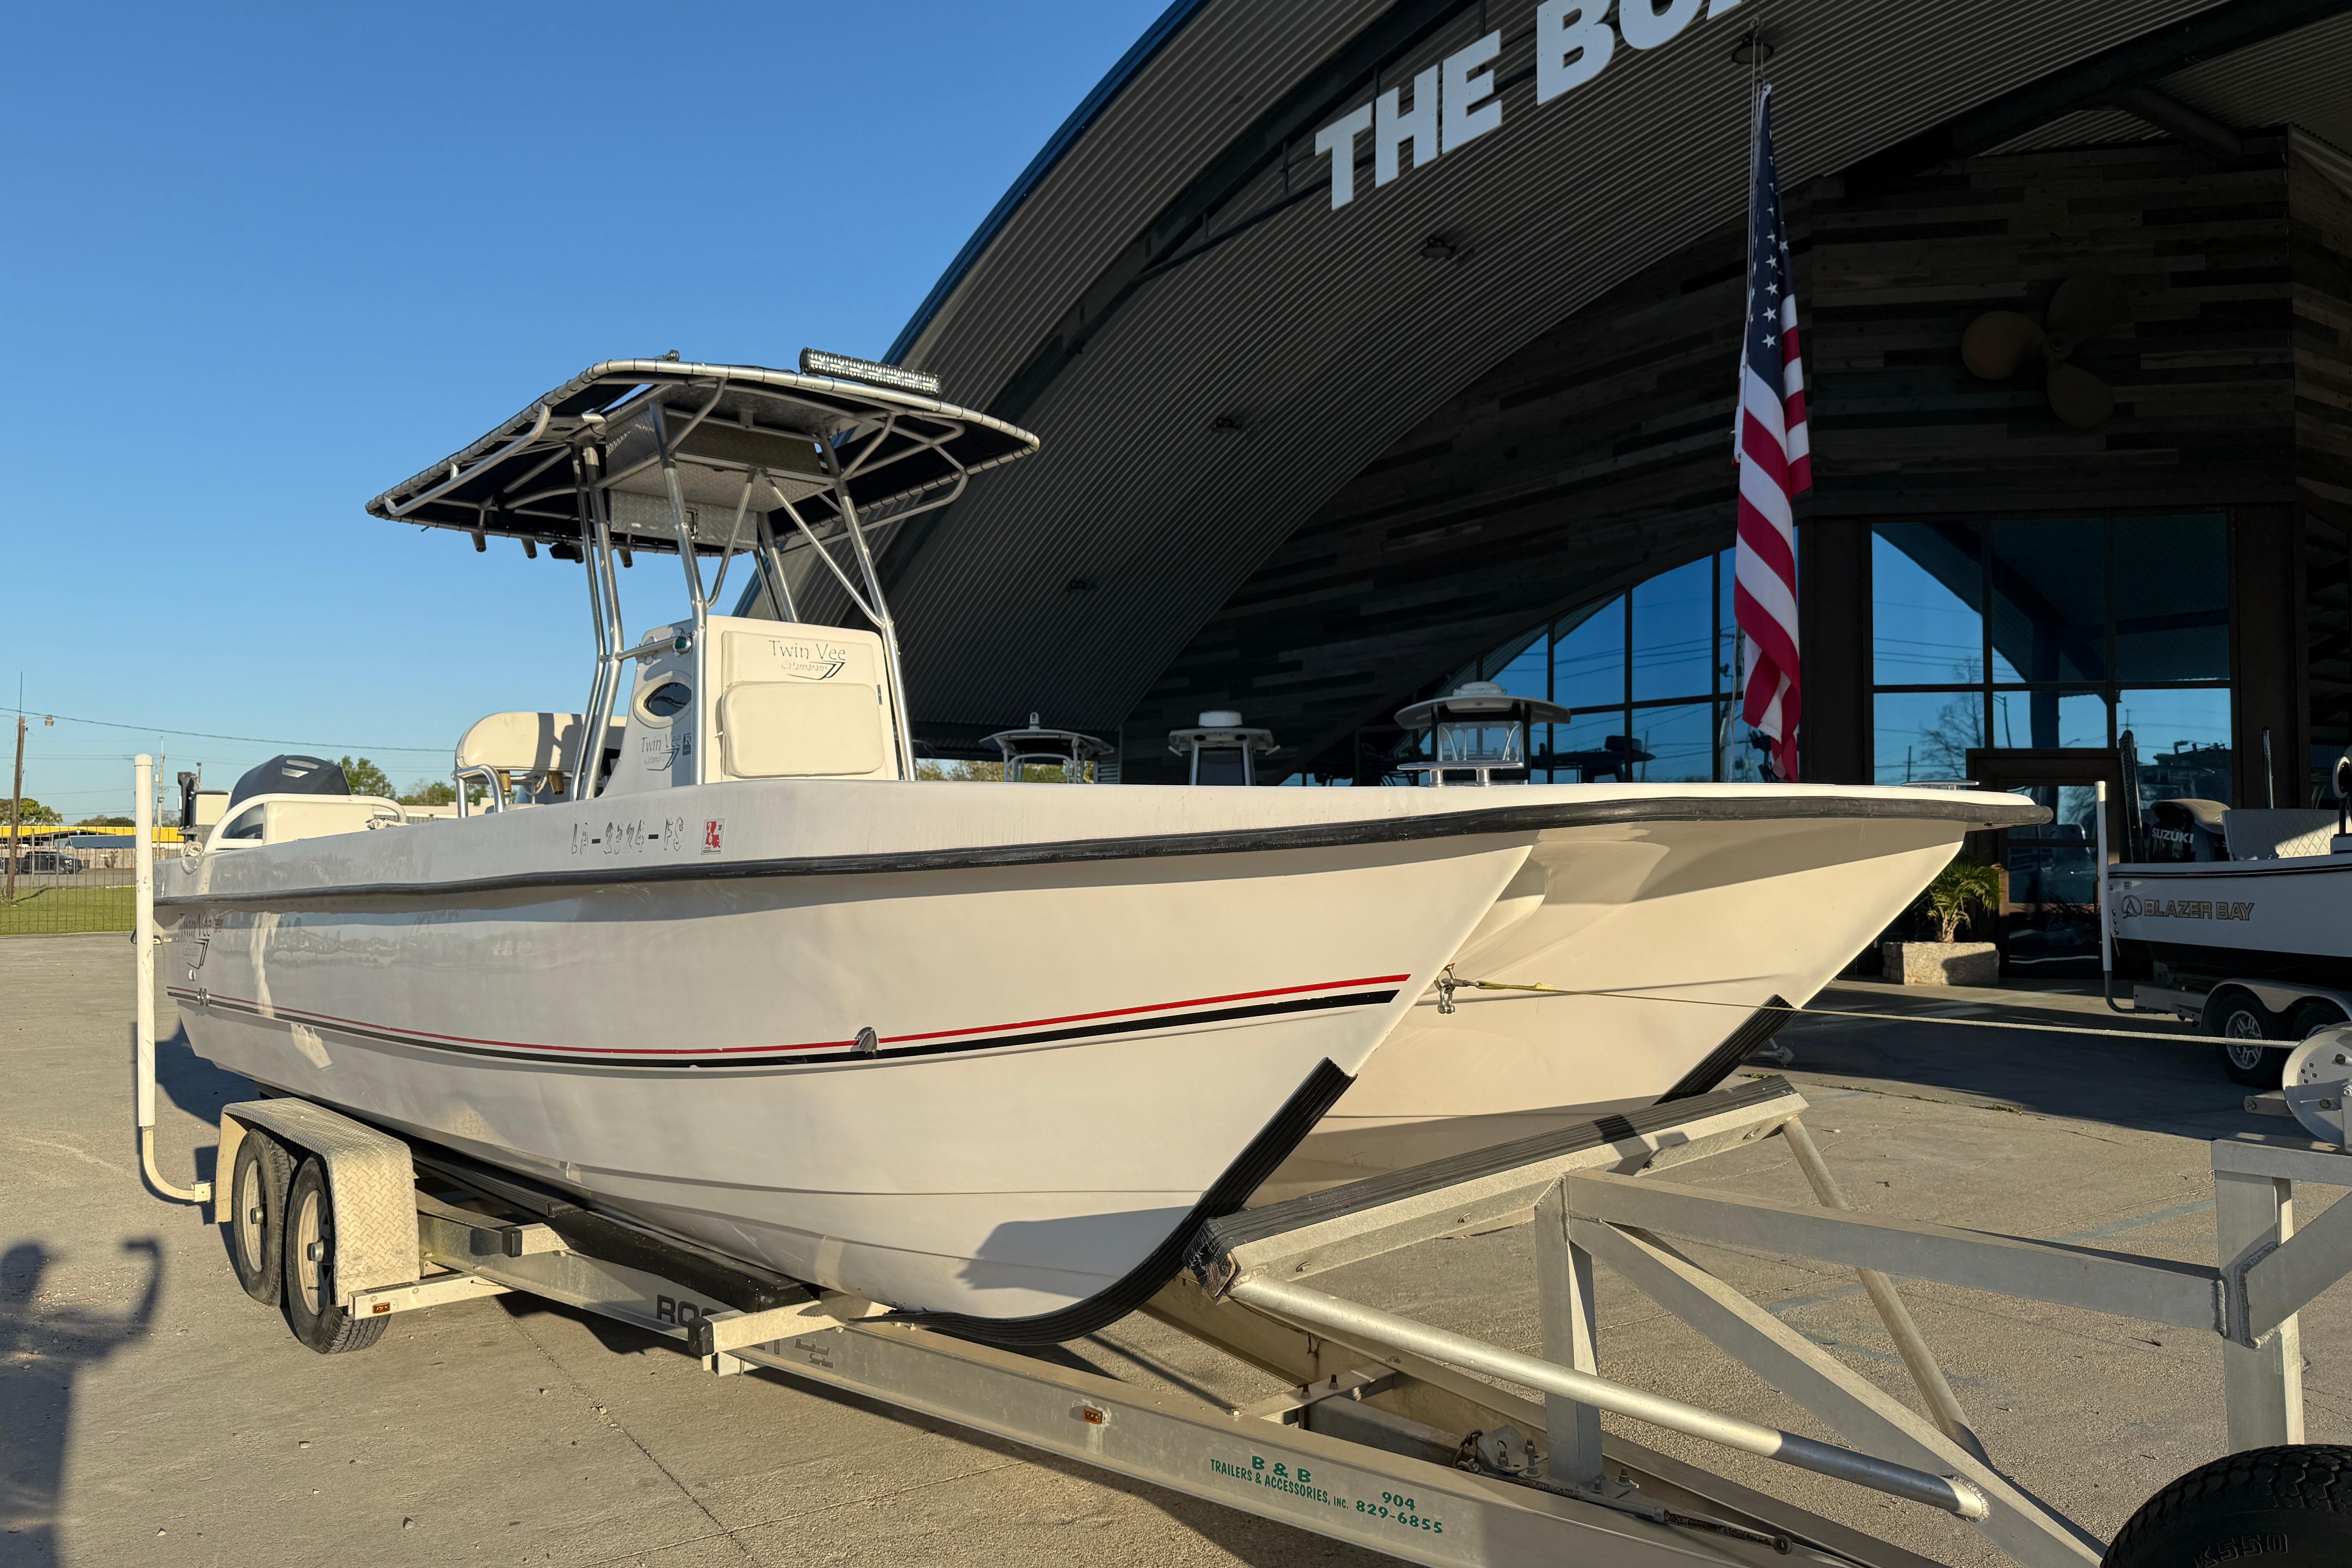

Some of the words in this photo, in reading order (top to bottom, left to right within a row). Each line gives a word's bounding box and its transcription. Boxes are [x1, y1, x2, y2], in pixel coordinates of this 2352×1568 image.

[1315, 29, 1503, 211] THE
[1536, 0, 1742, 106] BO
[768, 639, 809, 659] Twin
[816, 644, 846, 660] Vee
[641, 736, 661, 753] Twin
[665, 732, 681, 749] Vee
[2151, 828, 2194, 844] SUZUKI
[2144, 899, 2212, 919] BLAZER
[2216, 901, 2255, 921] BAY
[180, 913, 196, 938] Twin
[198, 912, 211, 937] Vee
[1252, 1455, 1265, 1470] B
[1273, 1462, 1289, 1478] &
[1297, 1468, 1311, 1483] B
[1210, 1458, 1252, 1482] TRAILERS
[1255, 1472, 1262, 1485] &
[1265, 1474, 1330, 1505] ACCESSORIES,
[1334, 1496, 1349, 1509] INC.
[1381, 1491, 1416, 1511] 904
[1356, 1500, 1443, 1534] 829-6855
